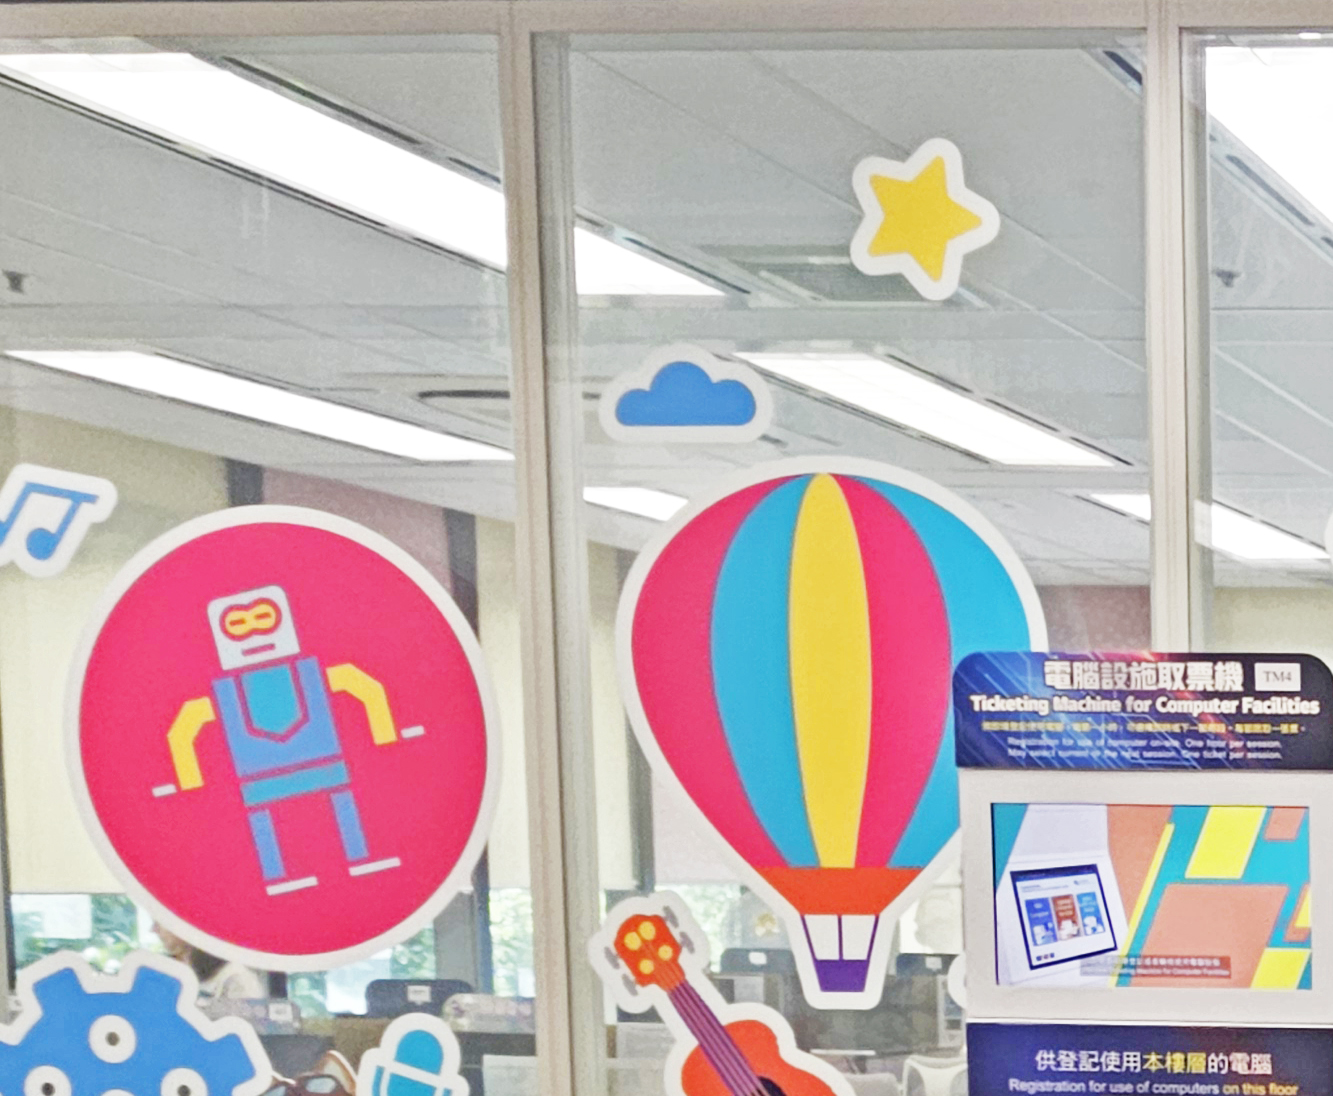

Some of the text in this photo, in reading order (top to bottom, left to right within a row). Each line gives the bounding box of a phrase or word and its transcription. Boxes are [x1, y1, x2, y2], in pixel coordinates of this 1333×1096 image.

[1044, 661, 1244, 692] 電腦設施取票機
[1264, 670, 1292, 684] TM4
[970, 694, 1321, 716] Ticketing Machine for Computer Facilities
[1035, 1050, 1273, 1075] 供登記使用本樓層的電腦
[1009, 1077, 1298, 1096] Registration for use of computers on this floor
